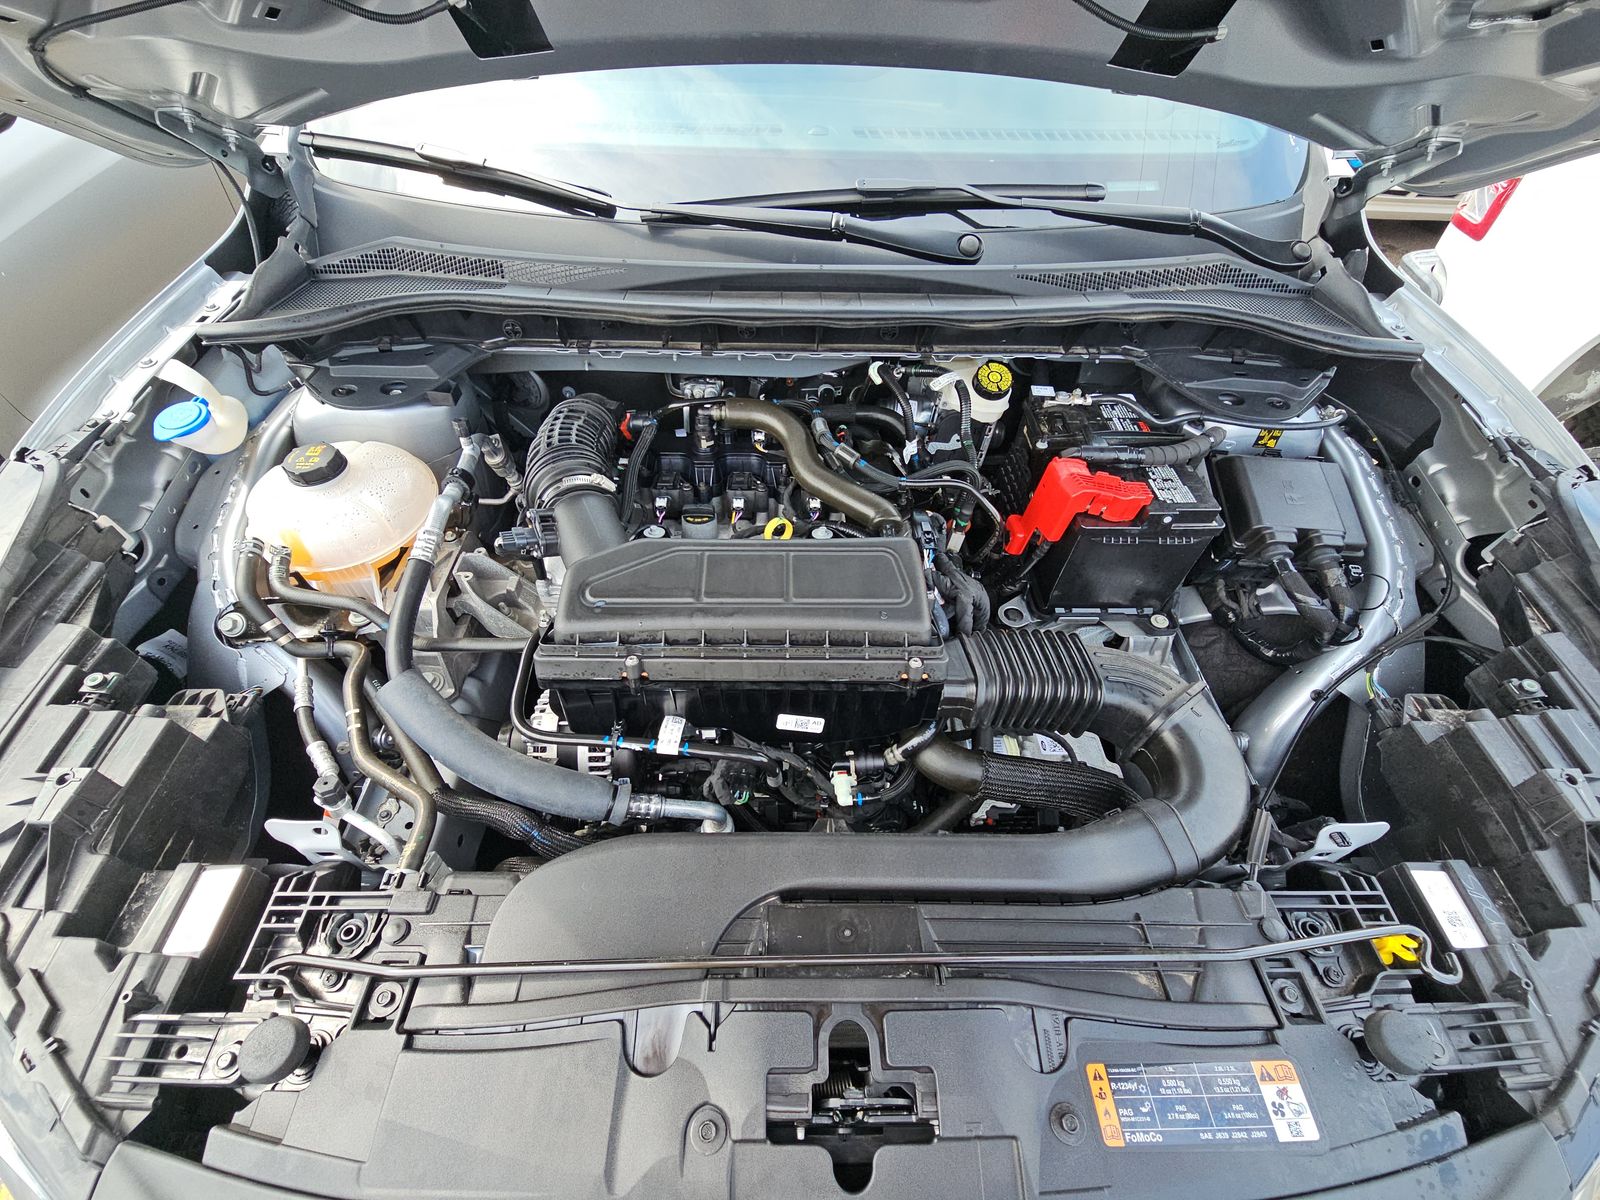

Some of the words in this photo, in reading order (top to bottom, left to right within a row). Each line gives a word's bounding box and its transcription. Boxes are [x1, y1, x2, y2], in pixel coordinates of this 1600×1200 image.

[1176, 1080, 1185, 1088] kg
[1232, 1078, 1240, 1086] kg
[1111, 1083, 1138, 1091] R-1234yf
[1125, 1132, 1163, 1142] FoMoCo
